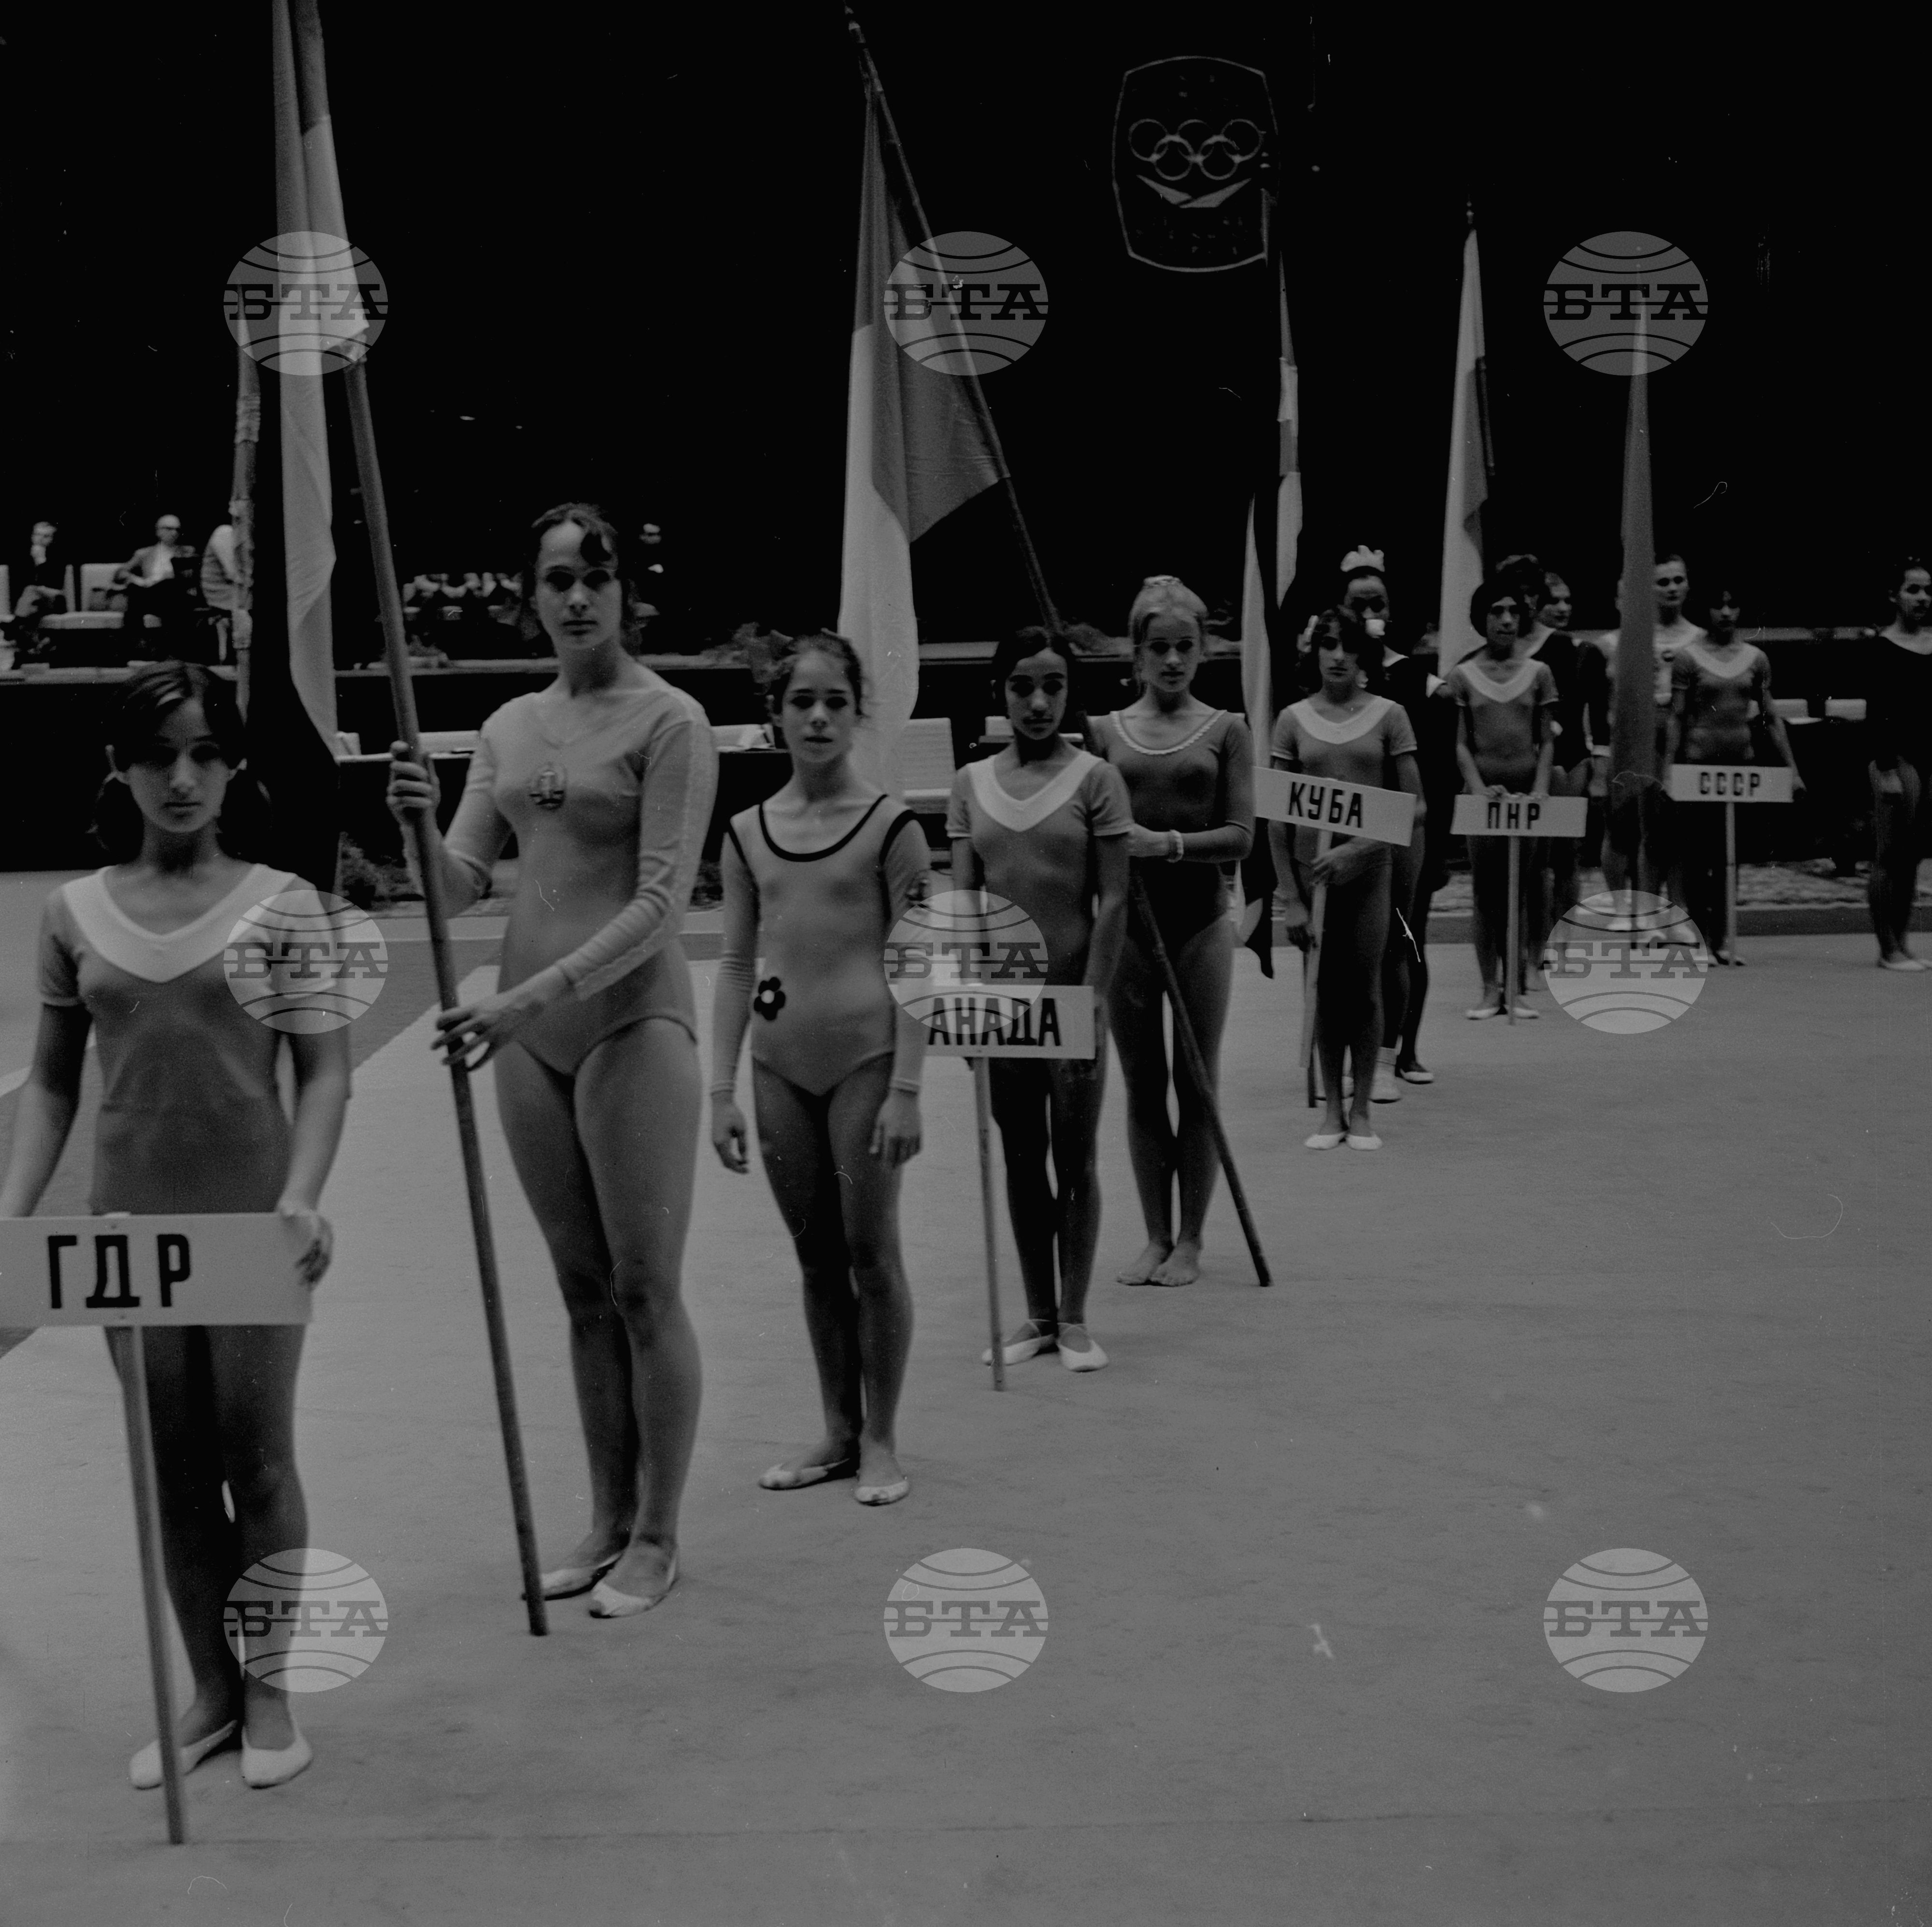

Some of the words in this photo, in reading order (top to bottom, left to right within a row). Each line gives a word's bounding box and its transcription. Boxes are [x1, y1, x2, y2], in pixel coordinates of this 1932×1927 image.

[1289, 781, 1362, 828] КУБА
[1700, 772, 1760, 796] СССР
[1488, 802, 1539, 829] ПНР
[928, 998, 1061, 1046] АНАДА
[48, 1234, 190, 1308] ГДР
